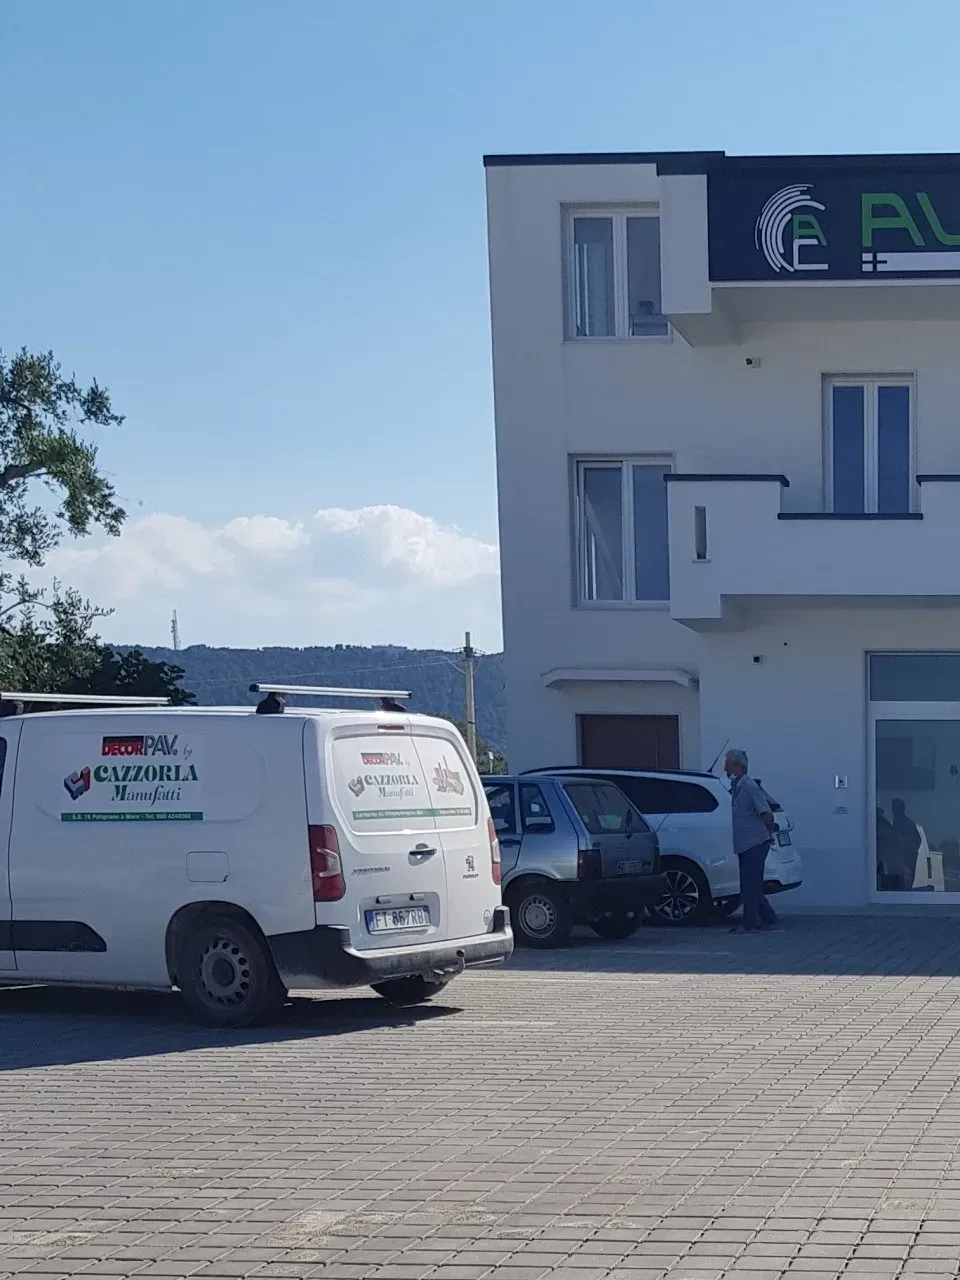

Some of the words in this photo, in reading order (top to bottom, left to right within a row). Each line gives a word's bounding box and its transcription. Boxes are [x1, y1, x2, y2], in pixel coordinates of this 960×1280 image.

[93, 764, 199, 783] CAZZORLA
[364, 774, 419, 786] CAZZORLA
[110, 784, 182, 807] Manufatti
